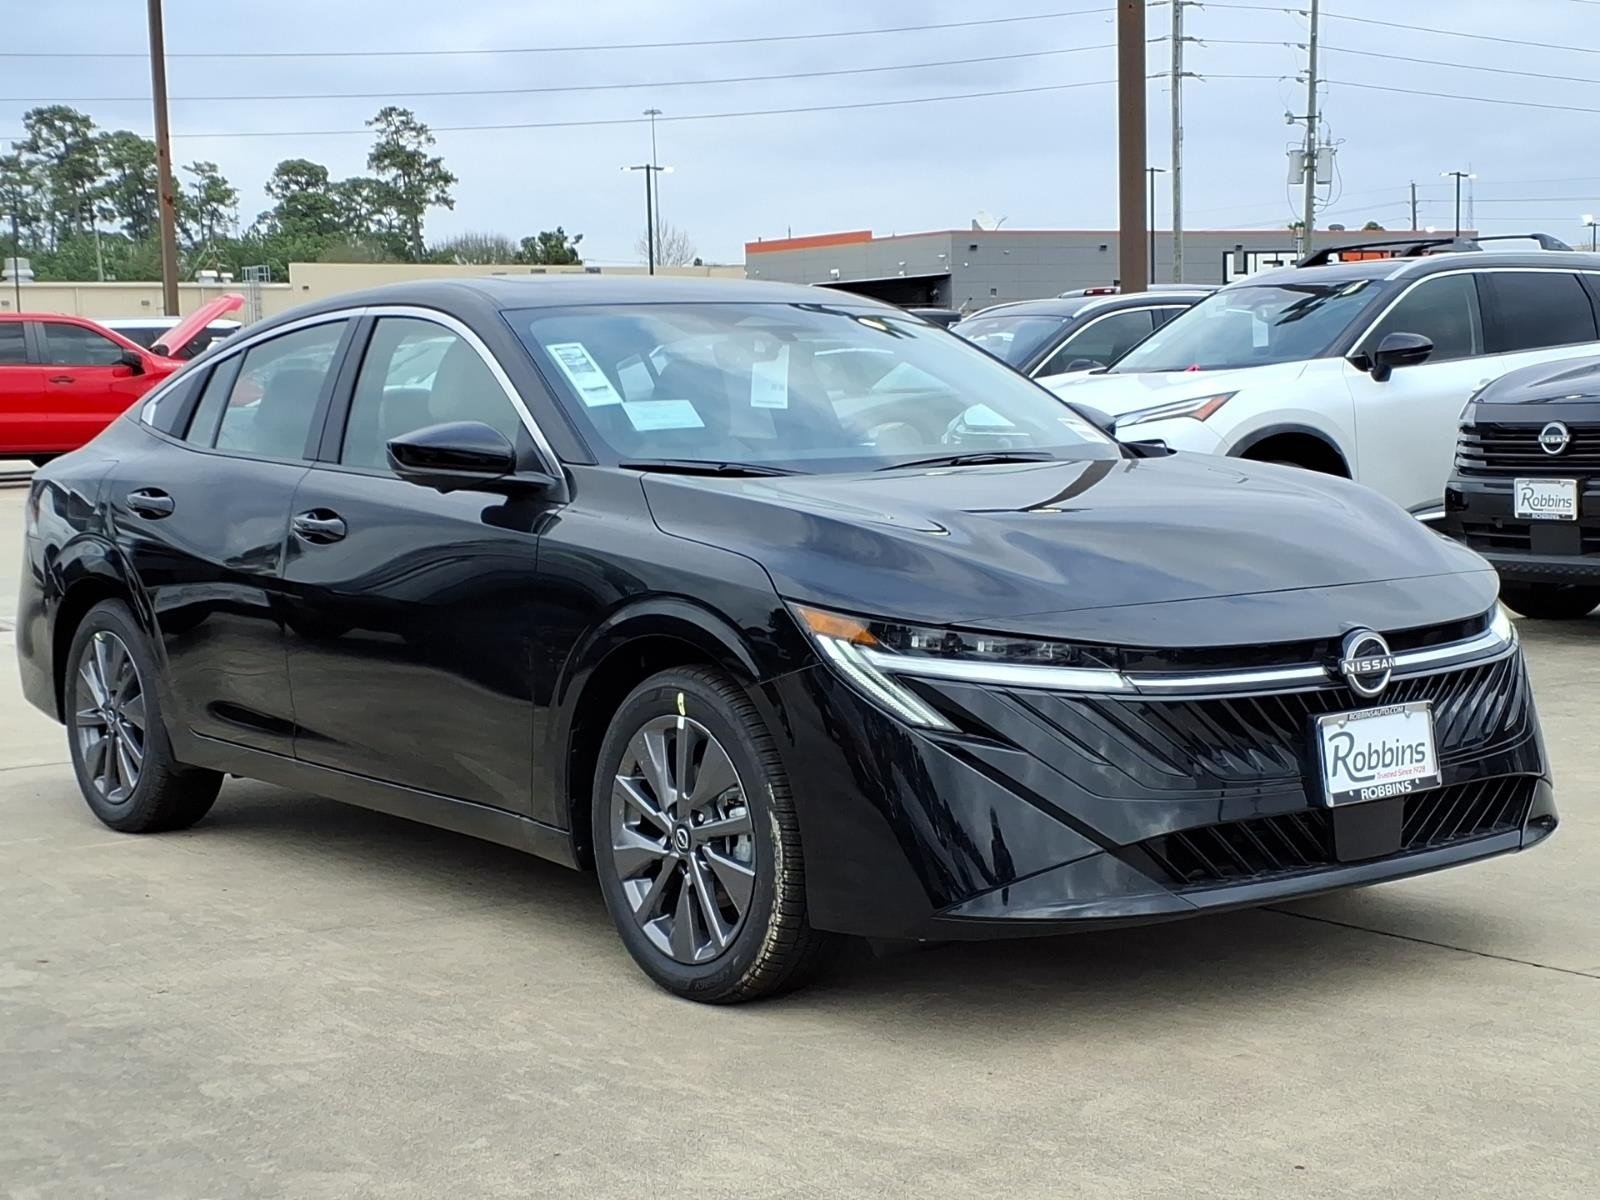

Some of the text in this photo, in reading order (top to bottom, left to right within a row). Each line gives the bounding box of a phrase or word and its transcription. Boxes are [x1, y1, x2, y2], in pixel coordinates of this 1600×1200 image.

[1521, 487, 1572, 511] Robbins
[1343, 657, 1395, 673] NISSAN
[1328, 731, 1426, 783] Robbins
[1361, 781, 1412, 800] ROBBINS
